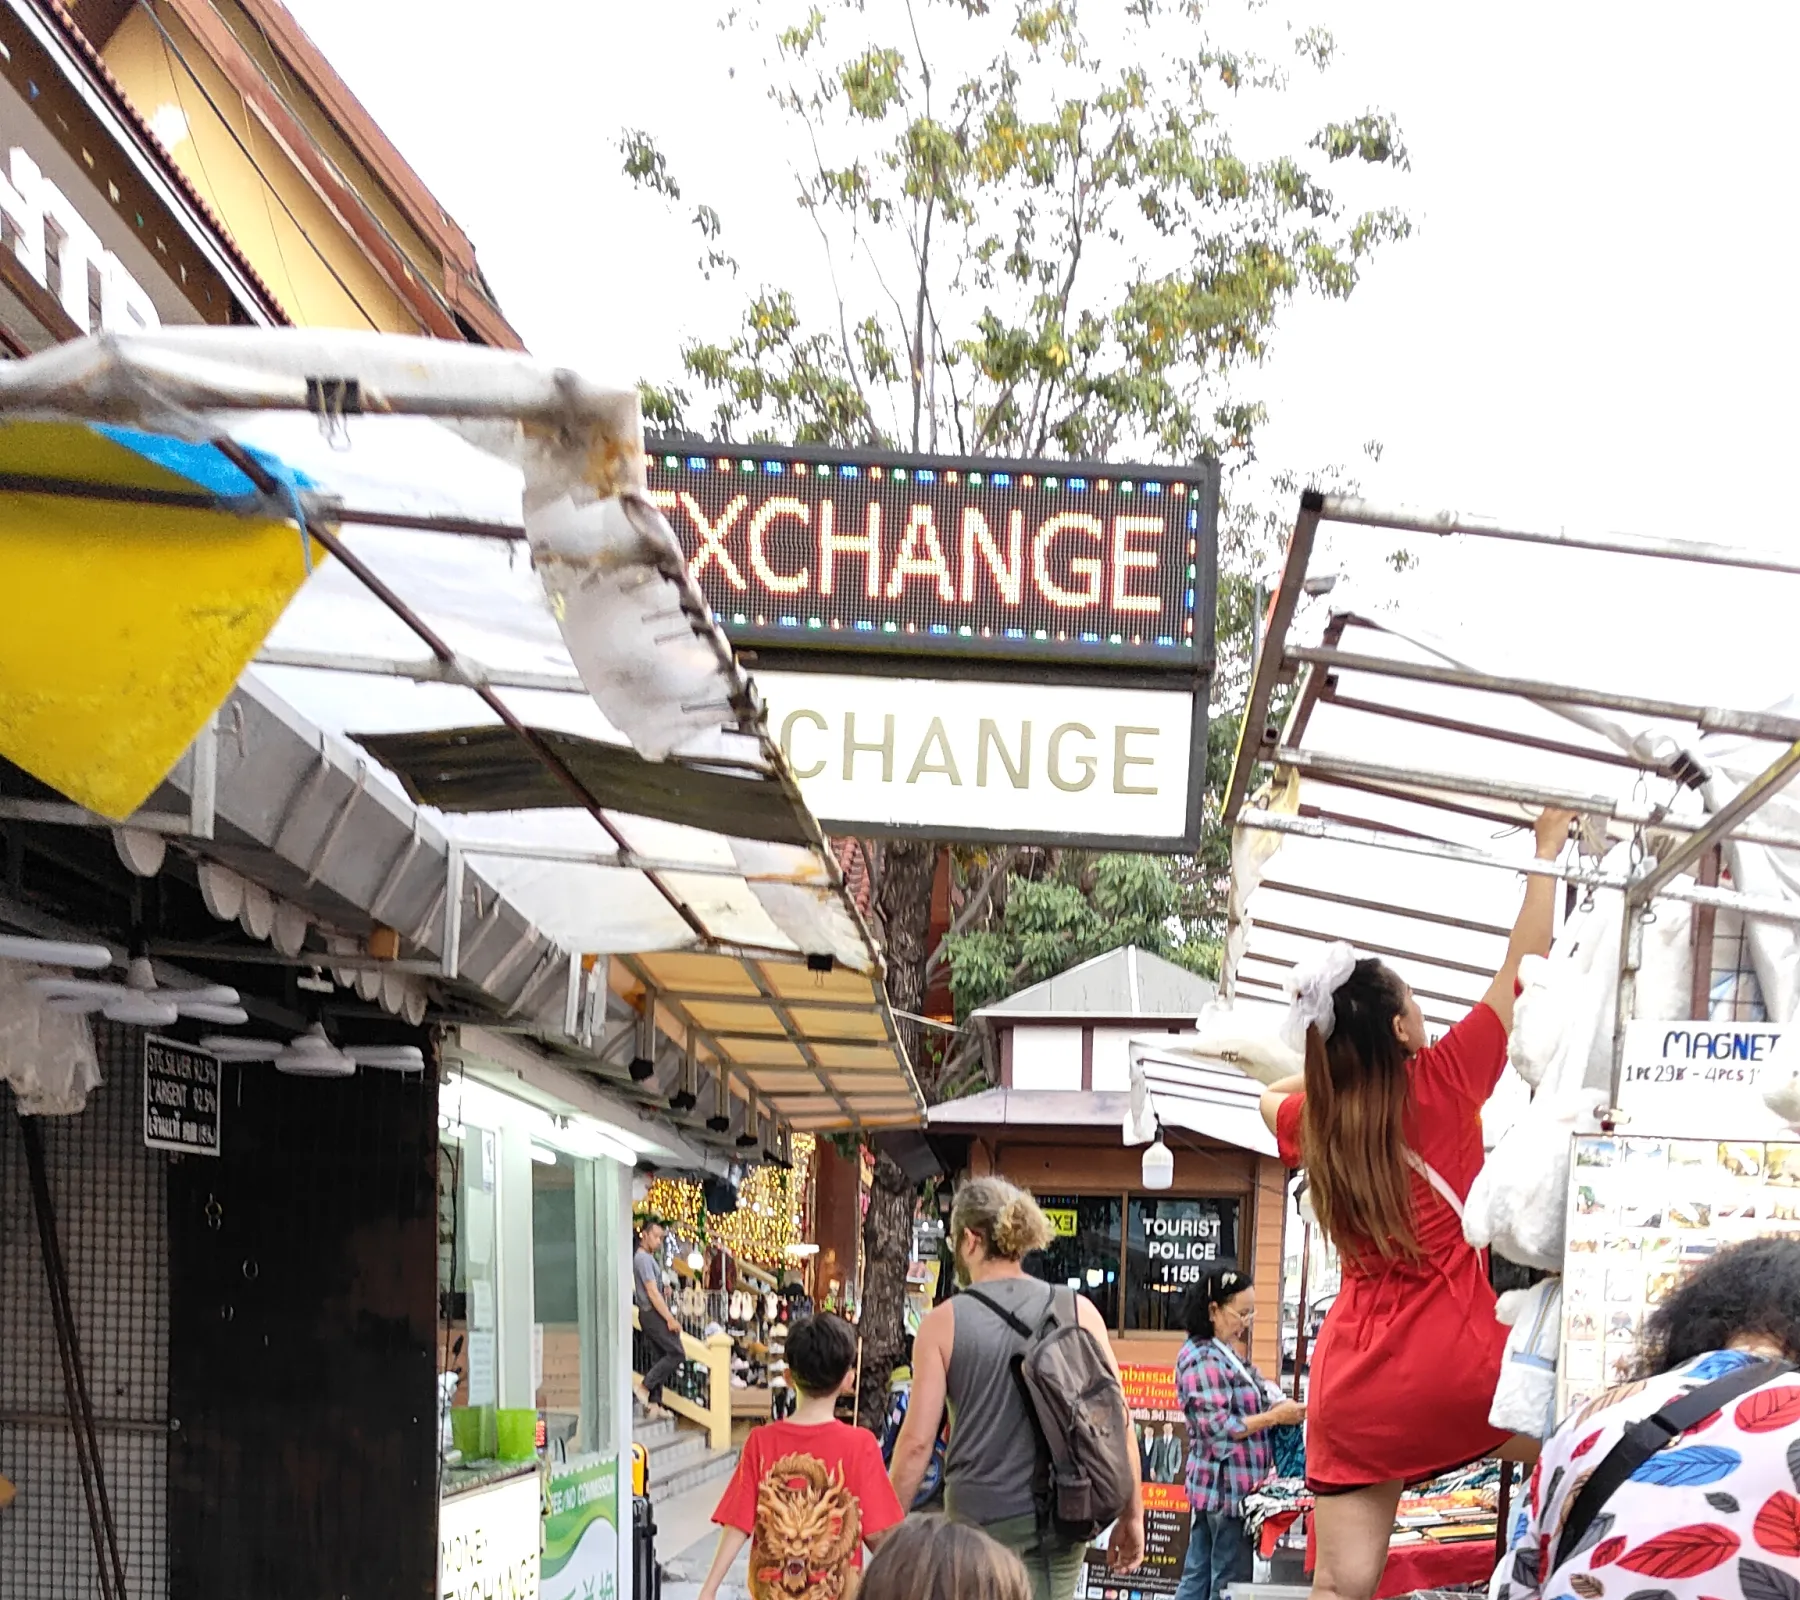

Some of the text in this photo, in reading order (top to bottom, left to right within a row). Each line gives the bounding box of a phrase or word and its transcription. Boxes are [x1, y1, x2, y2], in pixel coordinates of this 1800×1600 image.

[1143, 1218, 1221, 1237] TOURIST
[1149, 1242, 1216, 1261] POLICE
[1161, 1265, 1200, 1283] 1155
